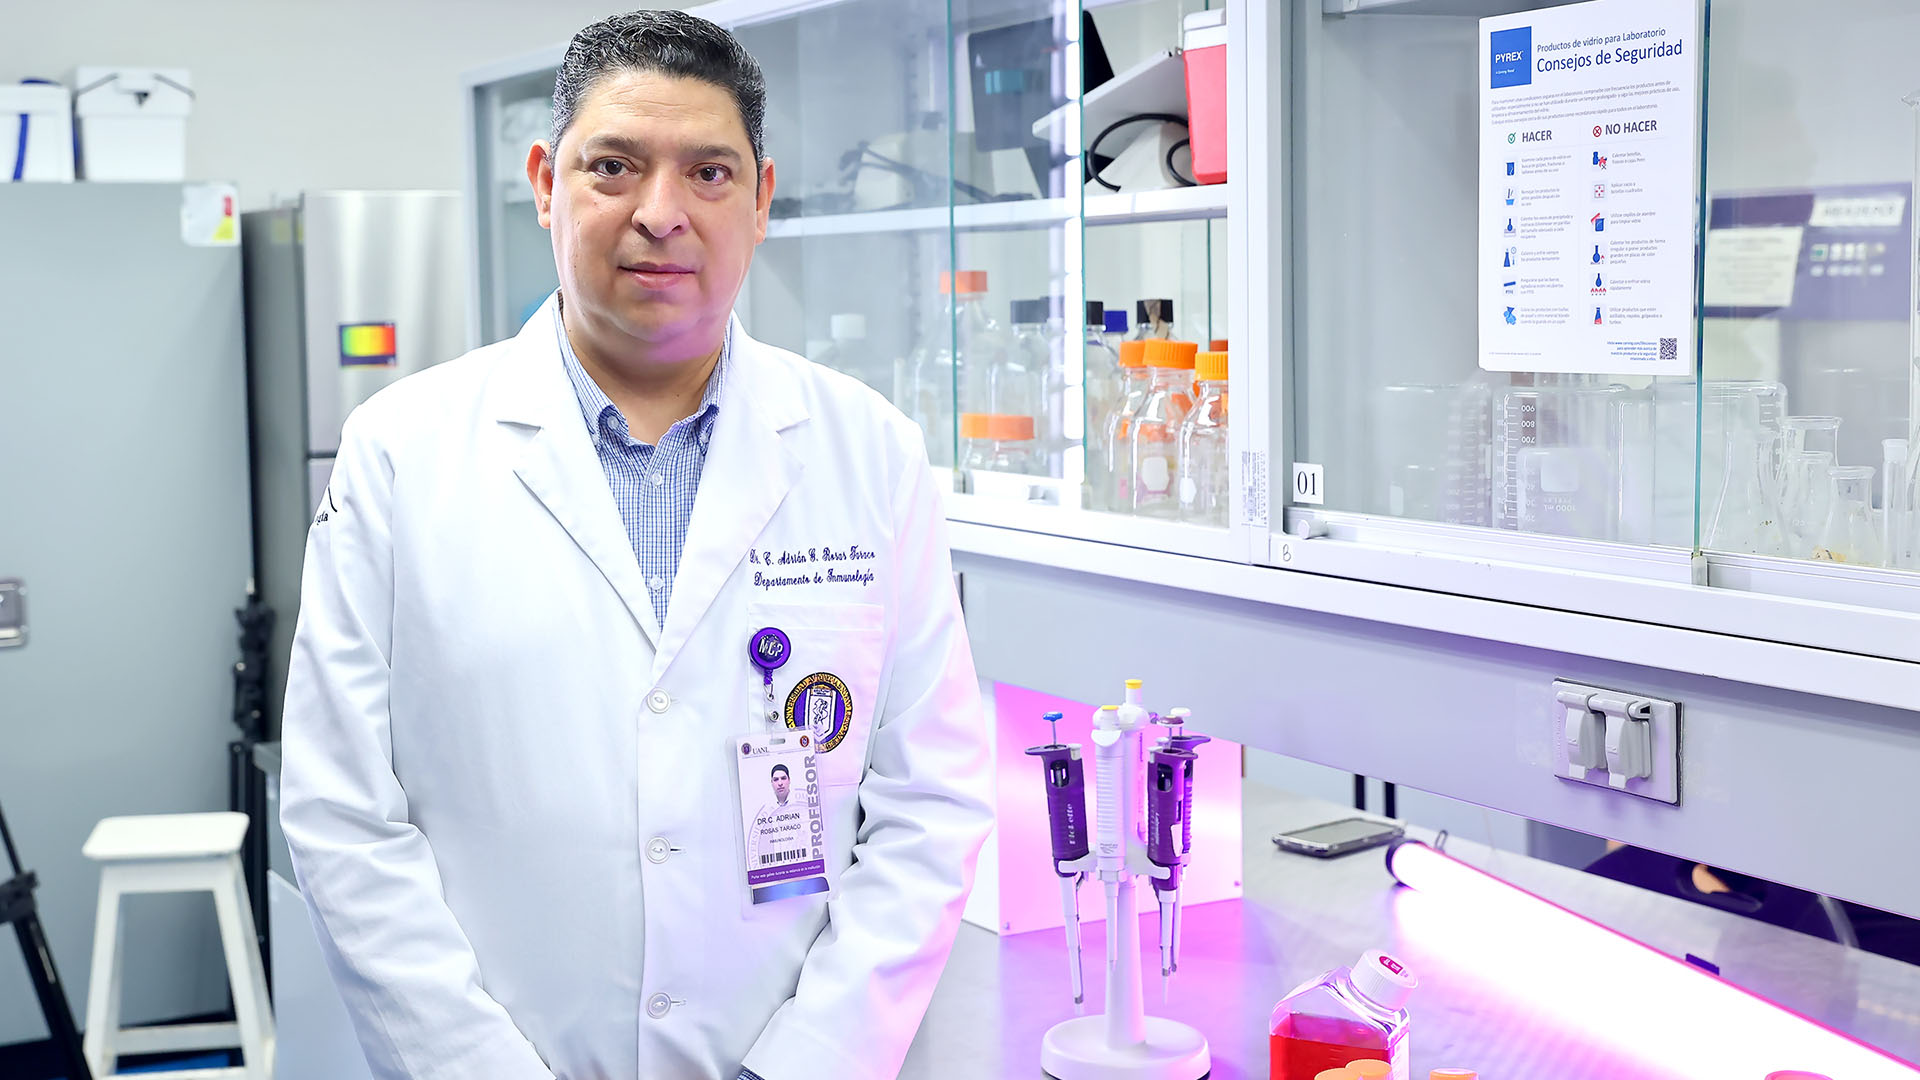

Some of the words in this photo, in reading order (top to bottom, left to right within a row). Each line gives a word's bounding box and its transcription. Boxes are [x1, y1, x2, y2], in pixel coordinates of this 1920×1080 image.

[1537, 41, 1571, 53] Productos
[1572, 38, 1581, 48] de
[1582, 35, 1603, 47] vidrio
[1604, 35, 1621, 48] para
[1622, 27, 1666, 42] Laboratorio
[1495, 51, 1521, 63] PYREX
[1537, 53, 1592, 73] Consejos
[1595, 49, 1611, 65] de
[1615, 39, 1683, 64] Seguridad
[1605, 123, 1621, 135] NO
[1623, 120, 1657, 133] HACER
[1522, 130, 1552, 142] HACER
[1521, 420, 1535, 428] 800
[1521, 435, 1535, 444] 700
[1297, 471, 1316, 495] 01
[1556, 504, 1577, 512] 1000
[777, 550, 806, 566] Adrián
[822, 546, 847, 562] Rosas
[753, 571, 811, 591] Departamento
[813, 571, 823, 584] de
[826, 568, 874, 587] Inmunología
[758, 638, 784, 657] MCP
[752, 746, 769, 755] UANL
[804, 755, 824, 859] PROFESOR
[776, 813, 800, 822] ADRIAN
[760, 826, 779, 835] ROSAS
[780, 823, 801, 832] TARACO
